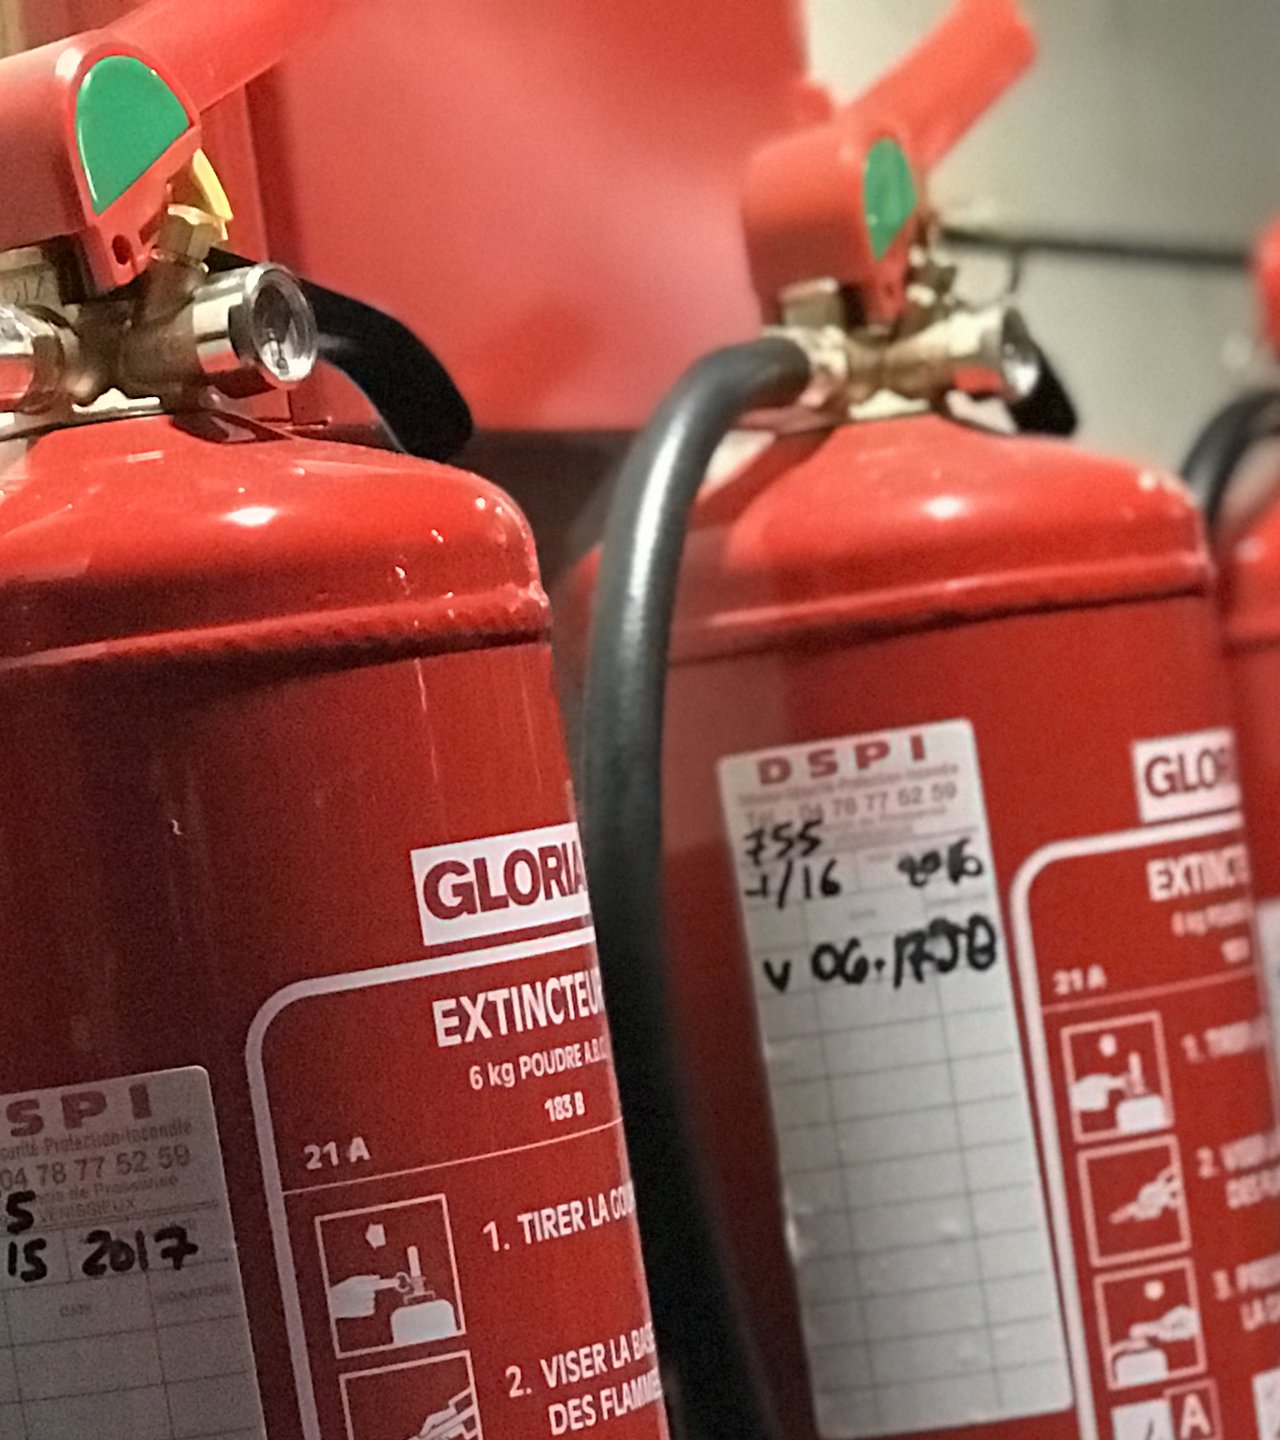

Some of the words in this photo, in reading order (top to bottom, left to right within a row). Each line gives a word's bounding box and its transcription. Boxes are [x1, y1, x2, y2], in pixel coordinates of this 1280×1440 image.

[470, 1064, 483, 1090] 6
[488, 1062, 515, 1088] kg
[519, 1044, 583, 1080] POUDRE
[545, 1095, 572, 1122] 183
[575, 1091, 585, 1115] B
[0, 1167, 28, 1191] 04
[36, 1162, 67, 1186] 78
[74, 1156, 106, 1181] 77
[117, 1151, 149, 1175] 52
[304, 1141, 339, 1170] 21
[349, 1136, 371, 1163] A
[483, 1220, 510, 1252] 1.
[517, 1201, 585, 1245] TIRER
[588, 1193, 610, 1228] LA
[82, 1225, 198, 1277] 2017
[504, 1365, 532, 1398] 2.
[540, 1343, 607, 1389] VISER
[609, 1335, 631, 1369] LA
[548, 1394, 596, 1436] DES
[1181, 1393, 1211, 1439] A
